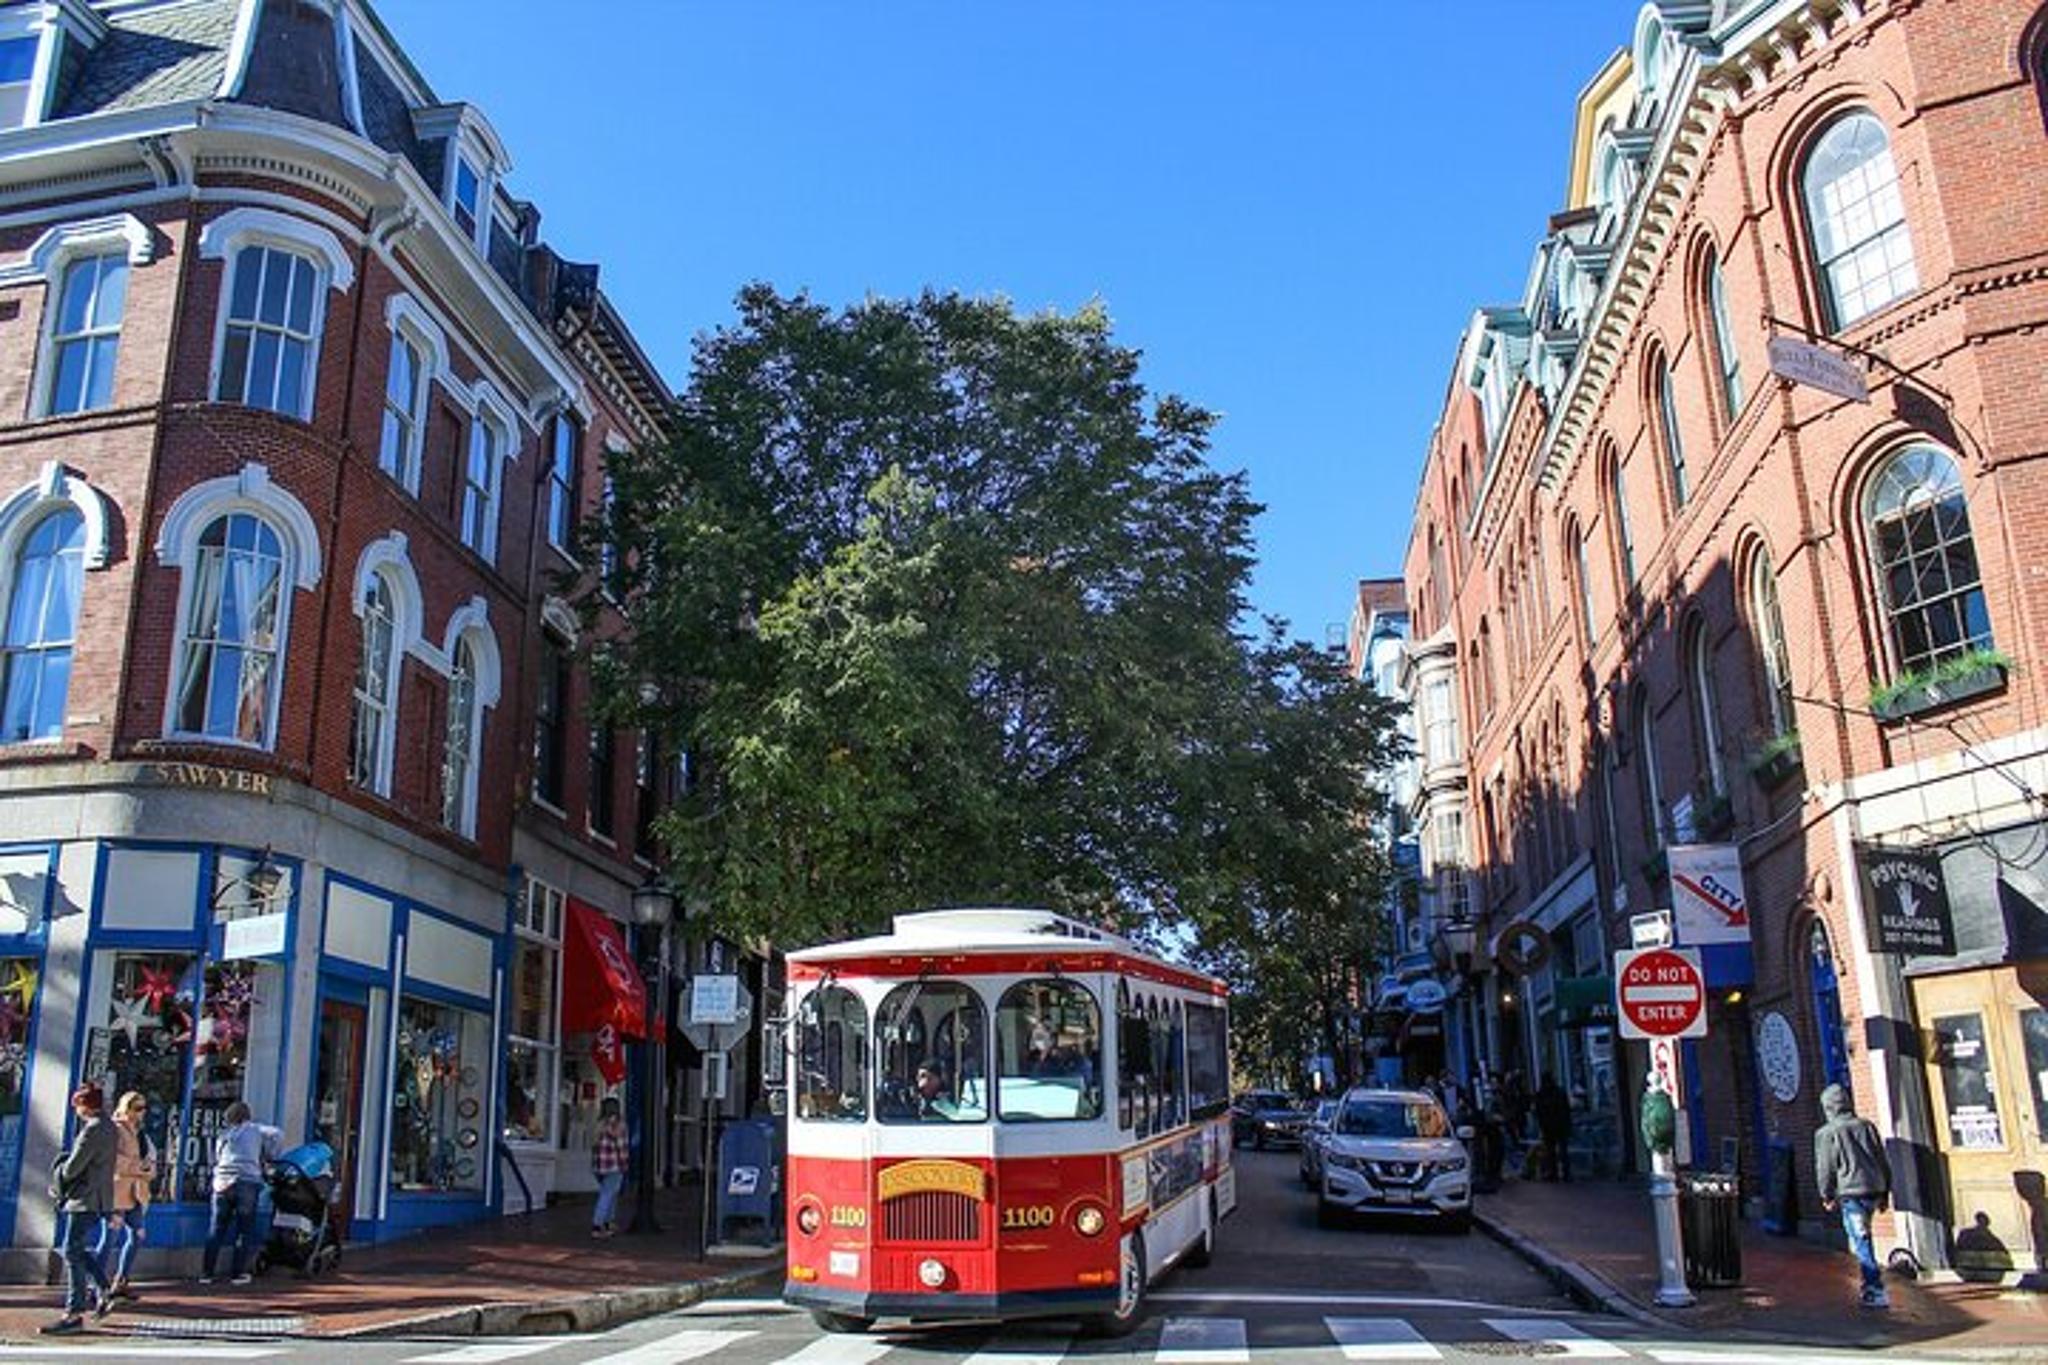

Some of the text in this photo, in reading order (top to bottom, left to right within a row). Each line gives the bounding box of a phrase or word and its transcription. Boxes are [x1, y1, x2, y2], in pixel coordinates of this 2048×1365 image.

[156, 764, 269, 793] SAWYER
[1870, 861, 1938, 892] PSYCHIC
[1700, 875, 1741, 908] CITY
[1630, 967, 1688, 982] DO NOT
[1638, 1006, 1686, 1020] ENTER
[830, 1206, 866, 1227] 1100
[1003, 1206, 1054, 1227] 1100
